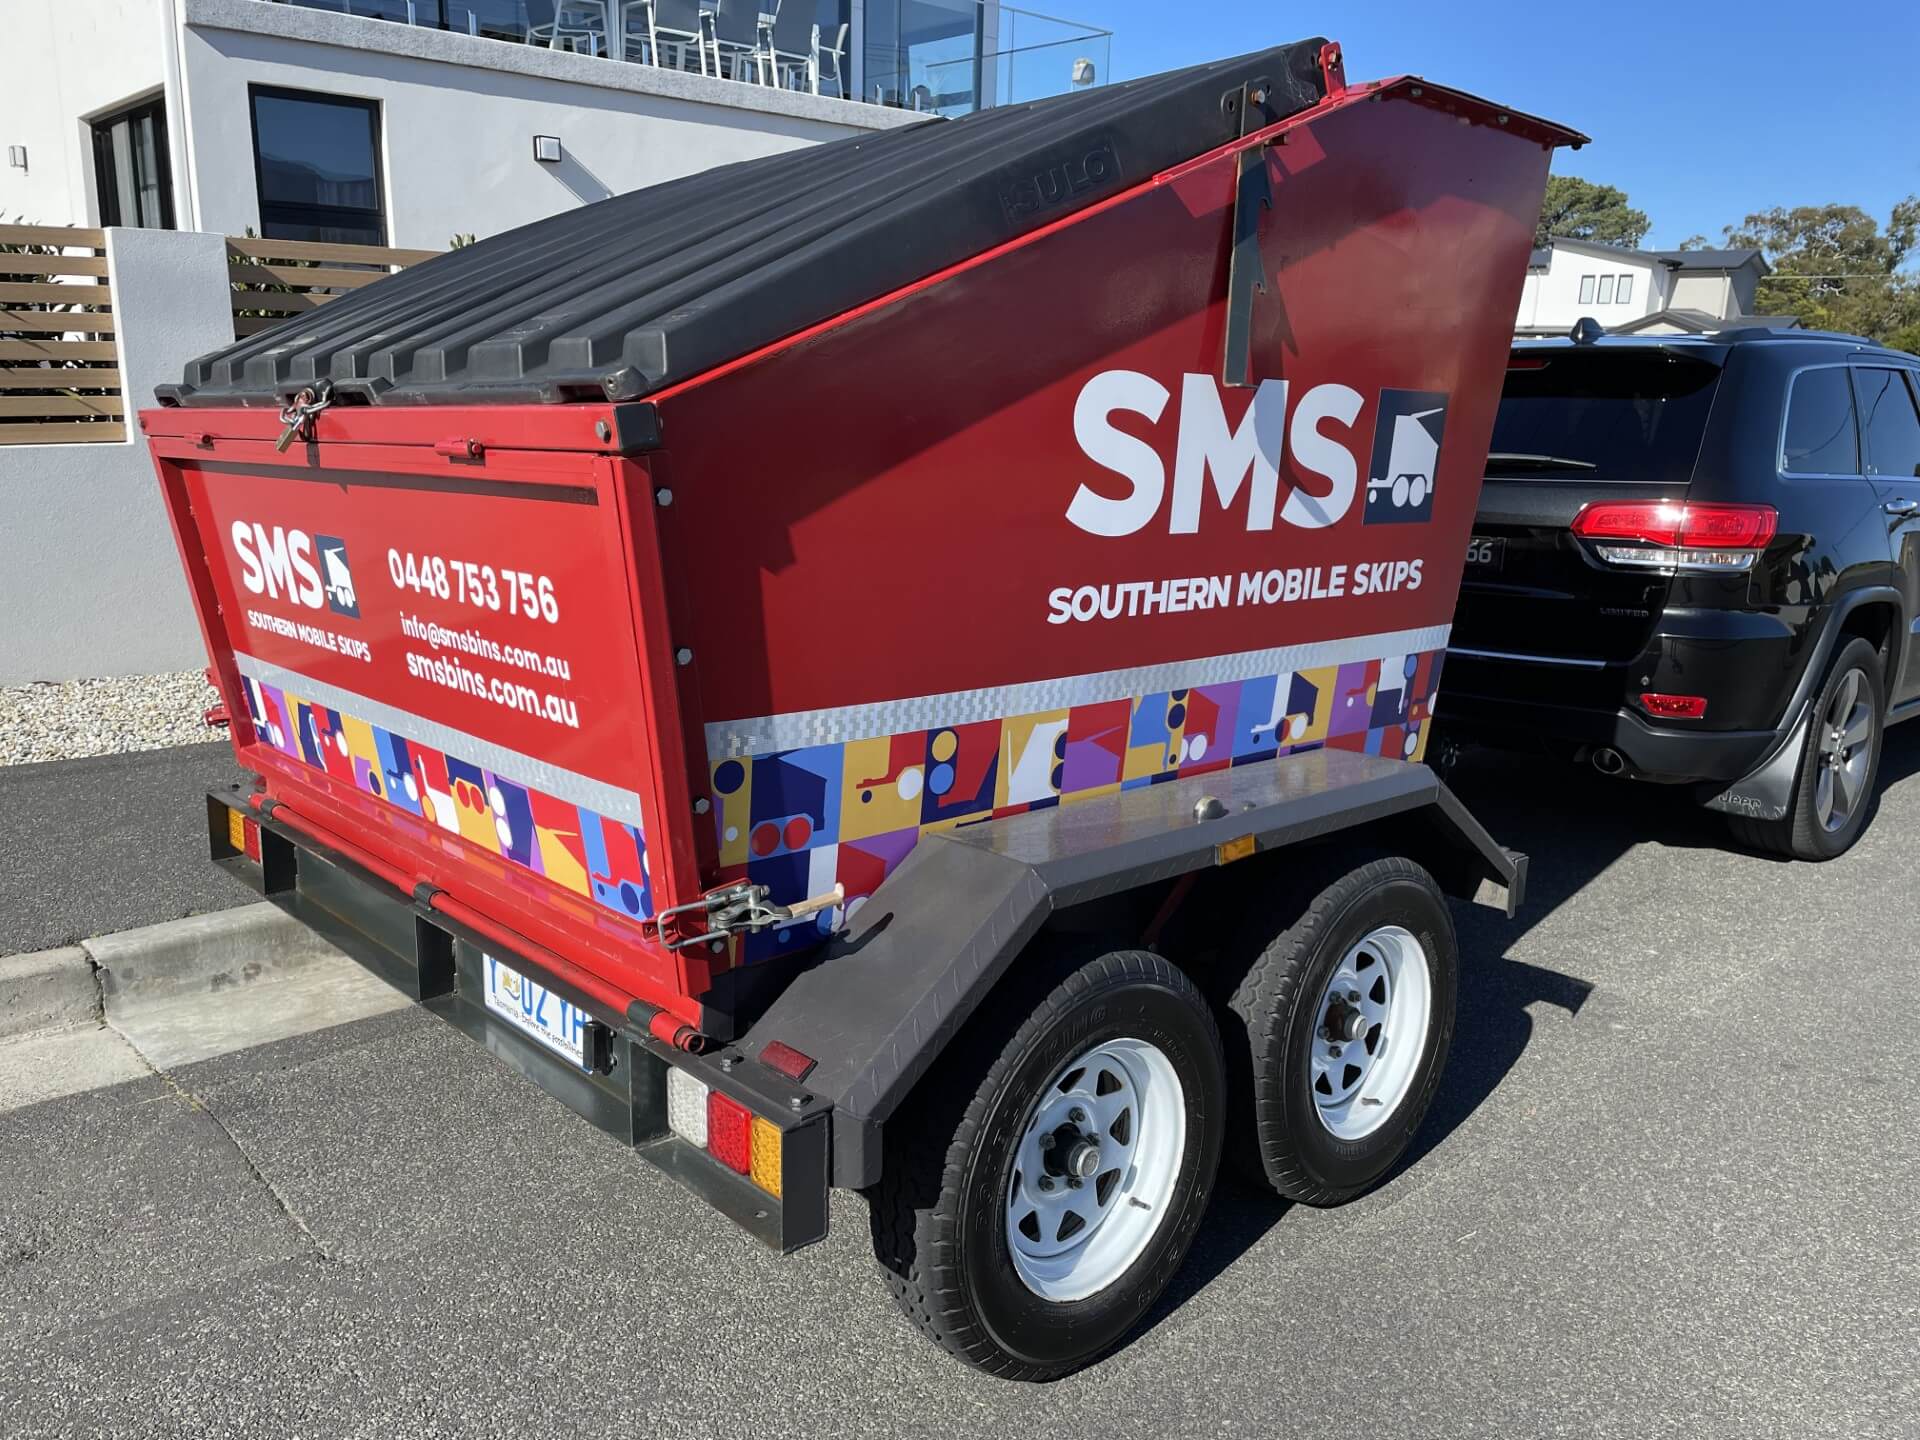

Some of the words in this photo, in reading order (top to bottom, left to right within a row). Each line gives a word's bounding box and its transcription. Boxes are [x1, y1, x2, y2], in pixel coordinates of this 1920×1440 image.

[1066, 369, 1365, 537] SMS
[231, 520, 324, 609] SMS
[387, 548, 450, 600] 0448
[450, 560, 501, 611] 753
[501, 569, 559, 624] 756
[1047, 575, 1232, 625] SOUTHERN
[1237, 565, 1348, 607] MOBILE
[1351, 558, 1424, 595] SKIPS
[248, 609, 298, 640] SOUTHERN
[297, 623, 338, 653] MOBILE
[337, 635, 372, 663] SKIPS
[399, 610, 571, 681] info@smsbins.com.au
[407, 651, 579, 729] smsbins.com.au
[1718, 790, 1762, 811] Jeep
